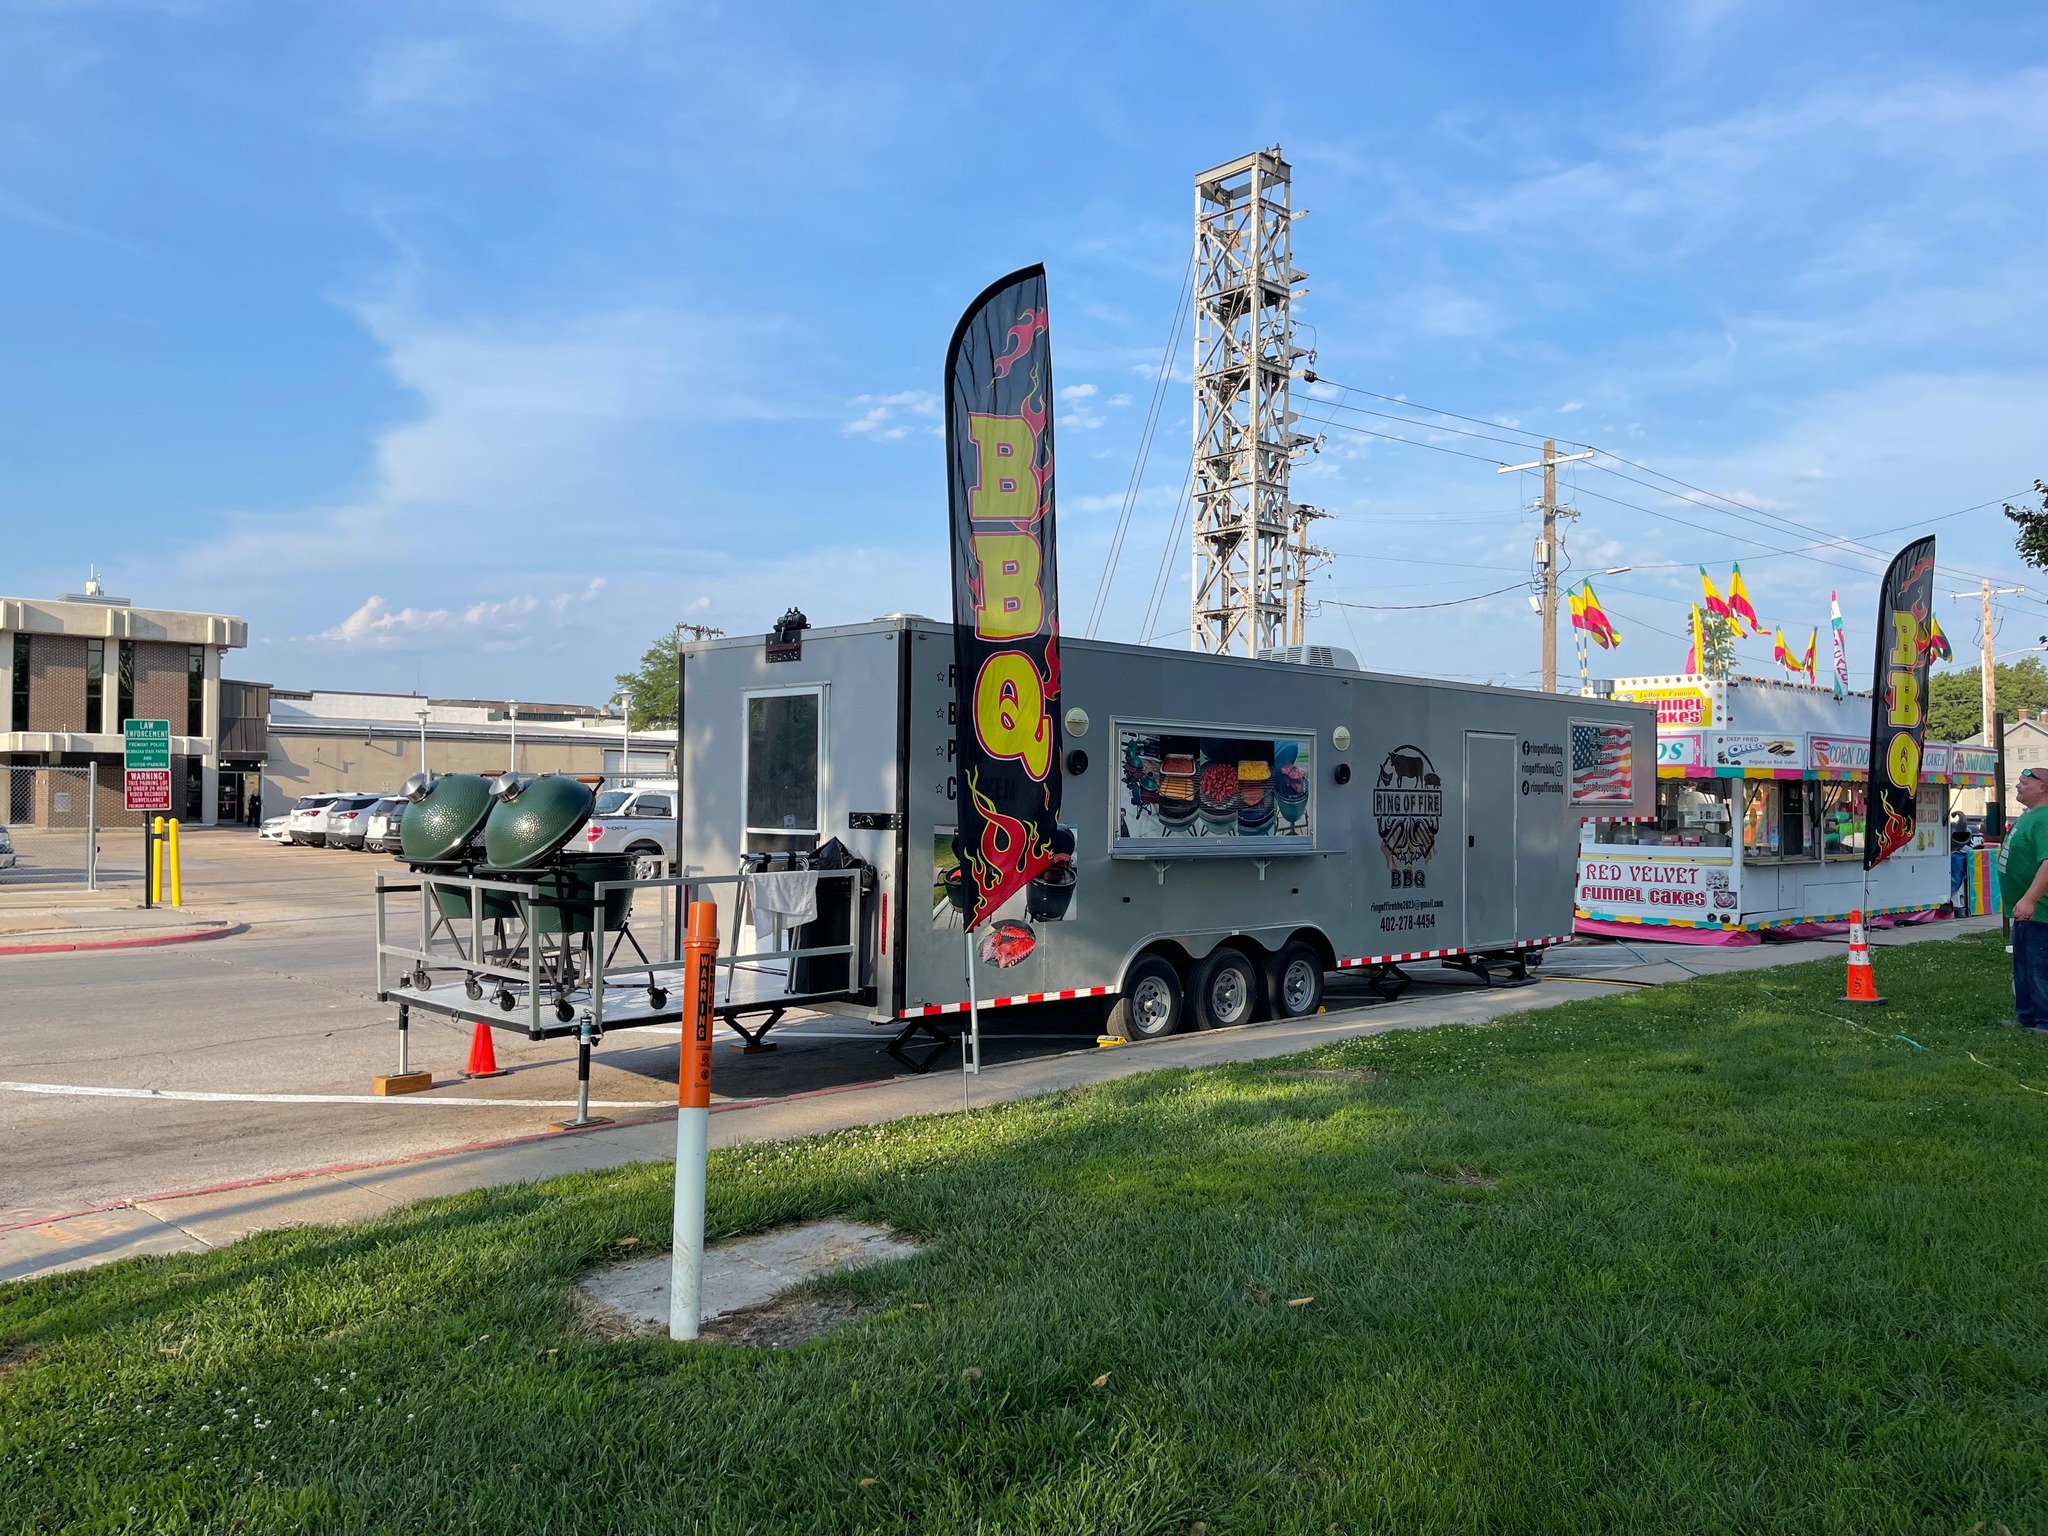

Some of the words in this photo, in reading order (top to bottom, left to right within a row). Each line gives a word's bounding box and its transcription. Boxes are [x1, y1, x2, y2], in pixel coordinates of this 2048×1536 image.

[968, 411, 1051, 782] BBQ
[1886, 610, 1921, 799] BBQ
[140, 721, 154, 730] LAW
[126, 730, 168, 738] ENFORCEMENT
[1530, 743, 1563, 756] ringoffirebbq
[1728, 743, 1765, 757] OREO
[1830, 746, 1854, 764] CORN
[1926, 753, 1945, 767] CAKES
[130, 772, 166, 780] WARNING!
[1522, 762, 1554, 776] ringoffirebbq
[1531, 782, 1563, 795] ringoffirebbq
[1376, 793, 1400, 812] RING
[1404, 794, 1416, 812] OF
[1418, 794, 1440, 812] FIRE
[1391, 869, 1426, 889] BBQ
[1586, 864, 1621, 880] RED
[1629, 866, 1699, 884] VELVET
[1370, 899, 1444, 913] ringoffirebbq2023@gmail.com
[1380, 914, 1435, 932] 402-278-4454
[698, 956, 710, 1038] WARNING
